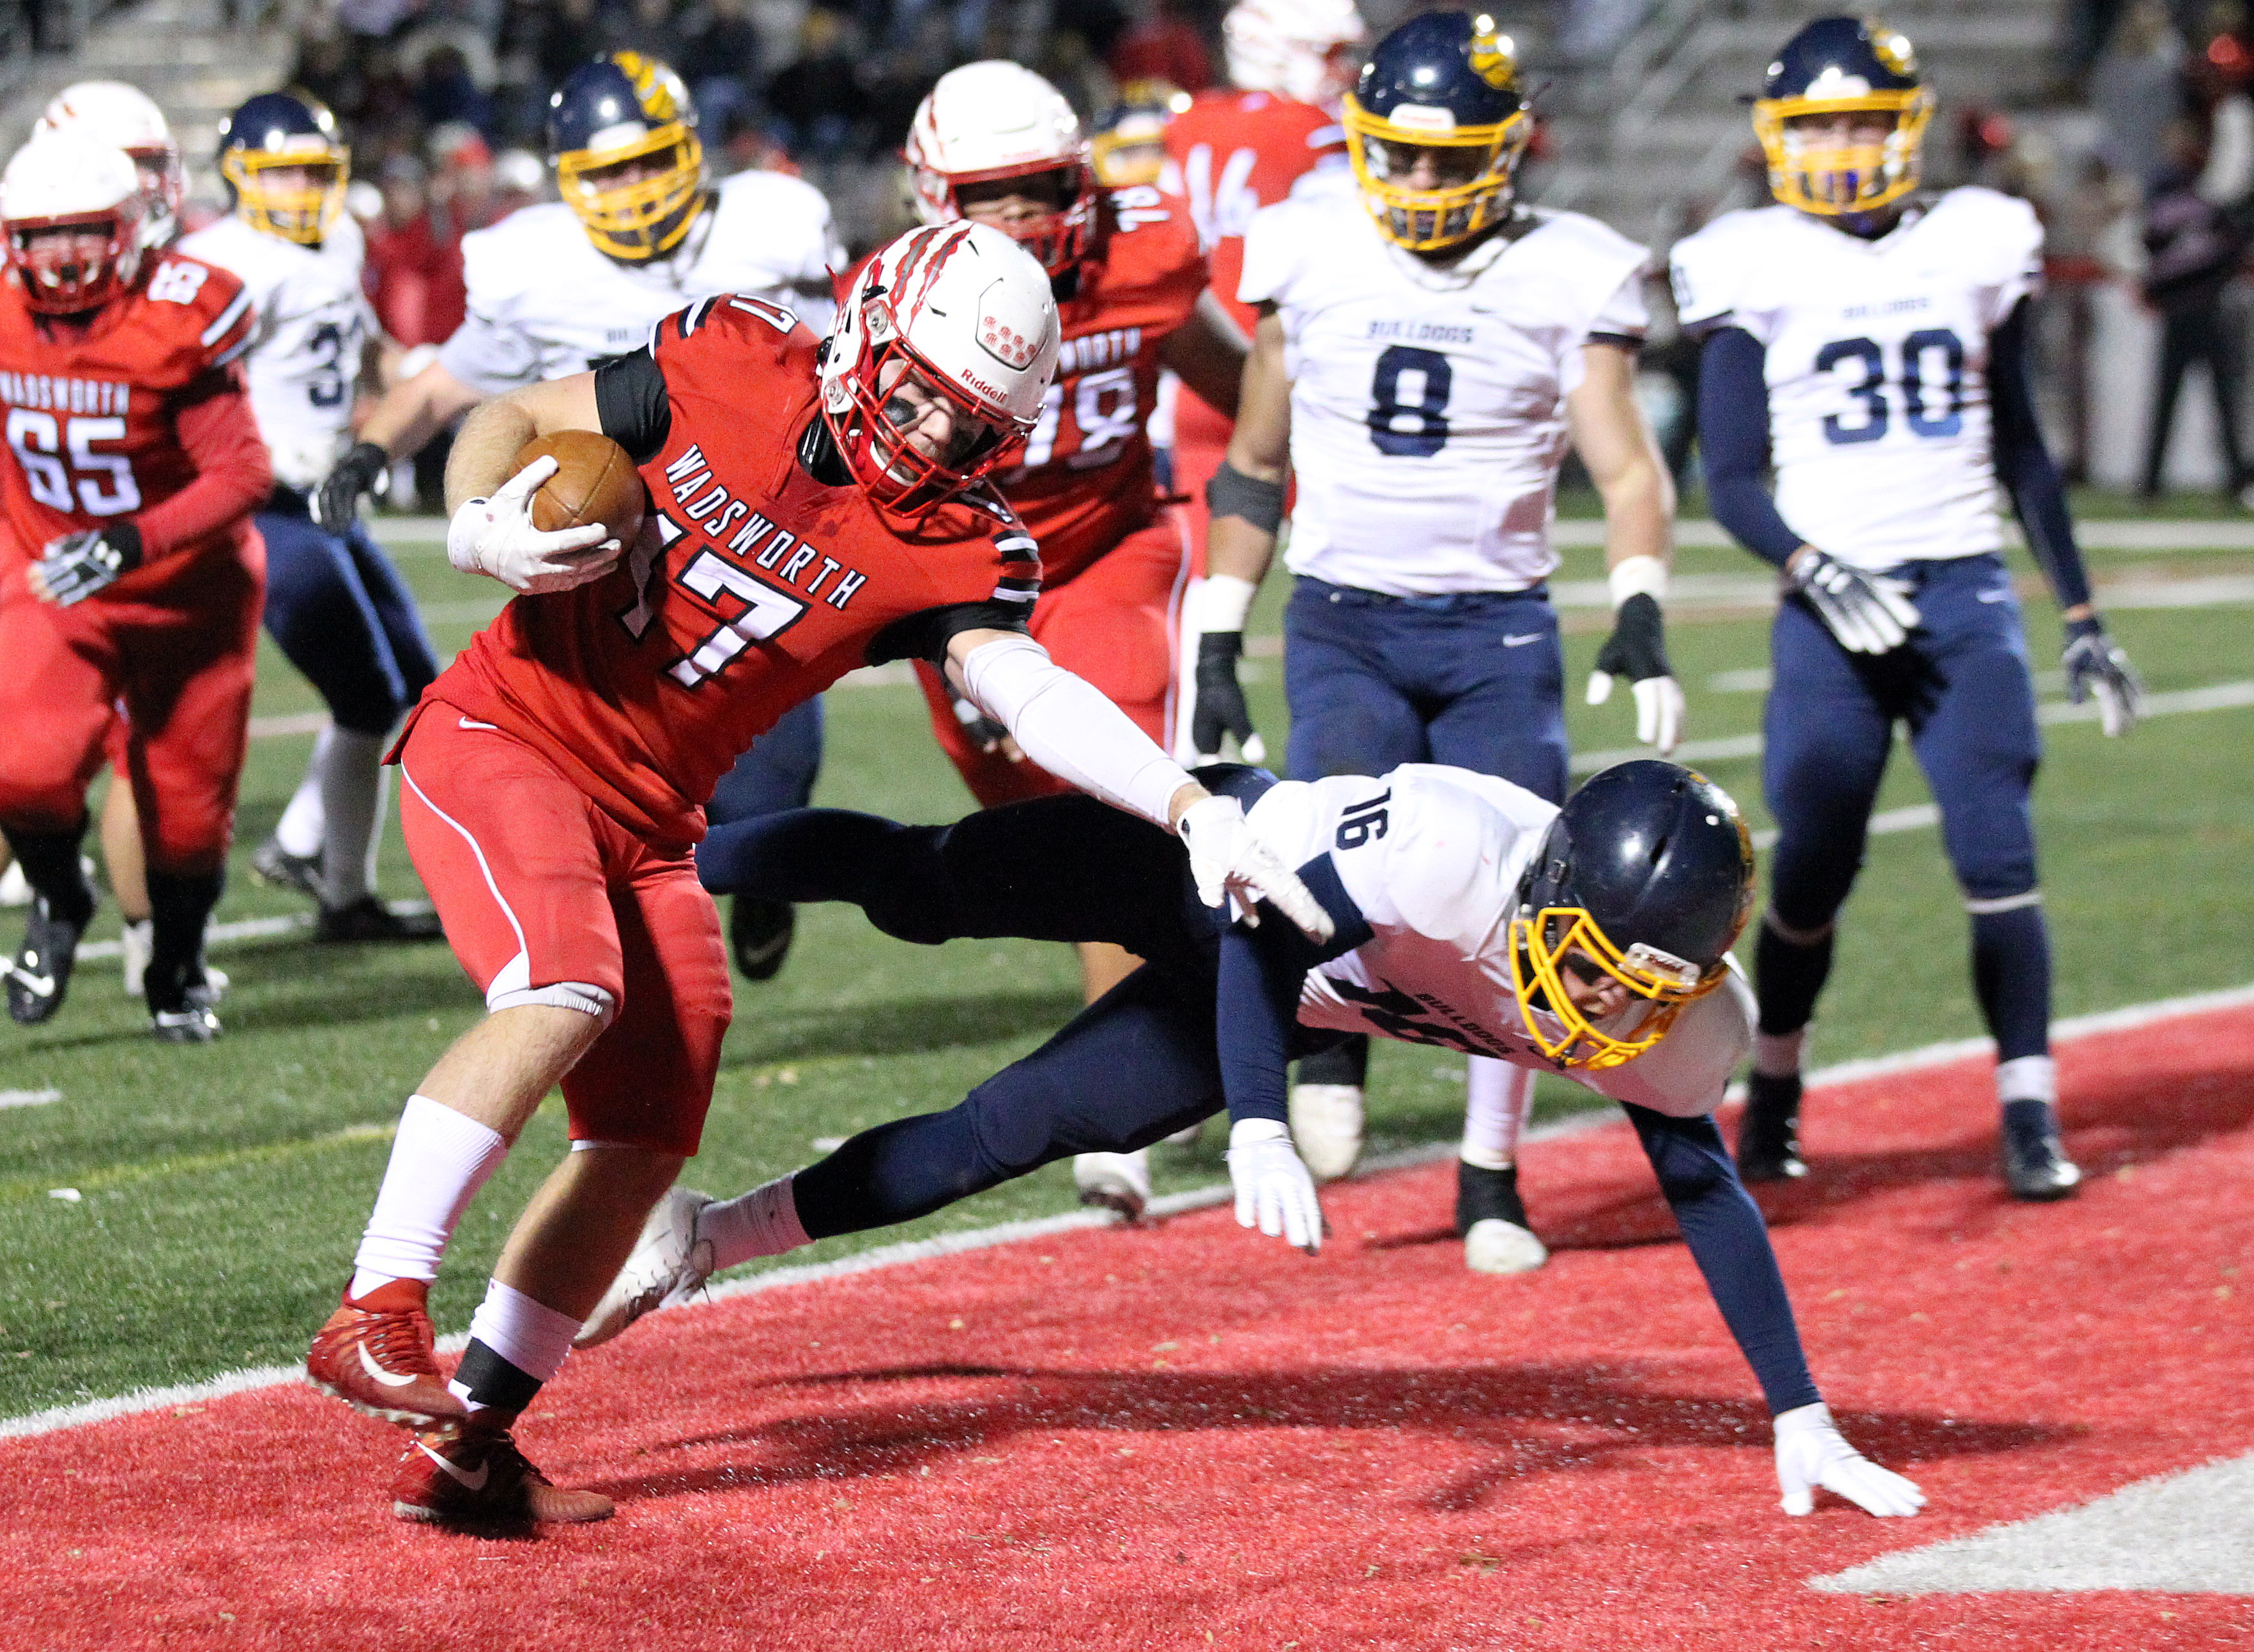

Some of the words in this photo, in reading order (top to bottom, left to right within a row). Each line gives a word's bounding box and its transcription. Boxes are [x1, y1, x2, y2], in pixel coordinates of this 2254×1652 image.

[960, 368, 1008, 404] Riddell
[1366, 321, 1473, 344] BULLDOGS
[1815, 328, 1963, 445] 30
[1366, 344, 1452, 458] 8
[5, 407, 142, 517] 65
[664, 443, 868, 611] WADSWORTH
[617, 509, 813, 690] 17
[1335, 786, 1392, 850] 16
[1413, 993, 1517, 1054] BULLDOGS
